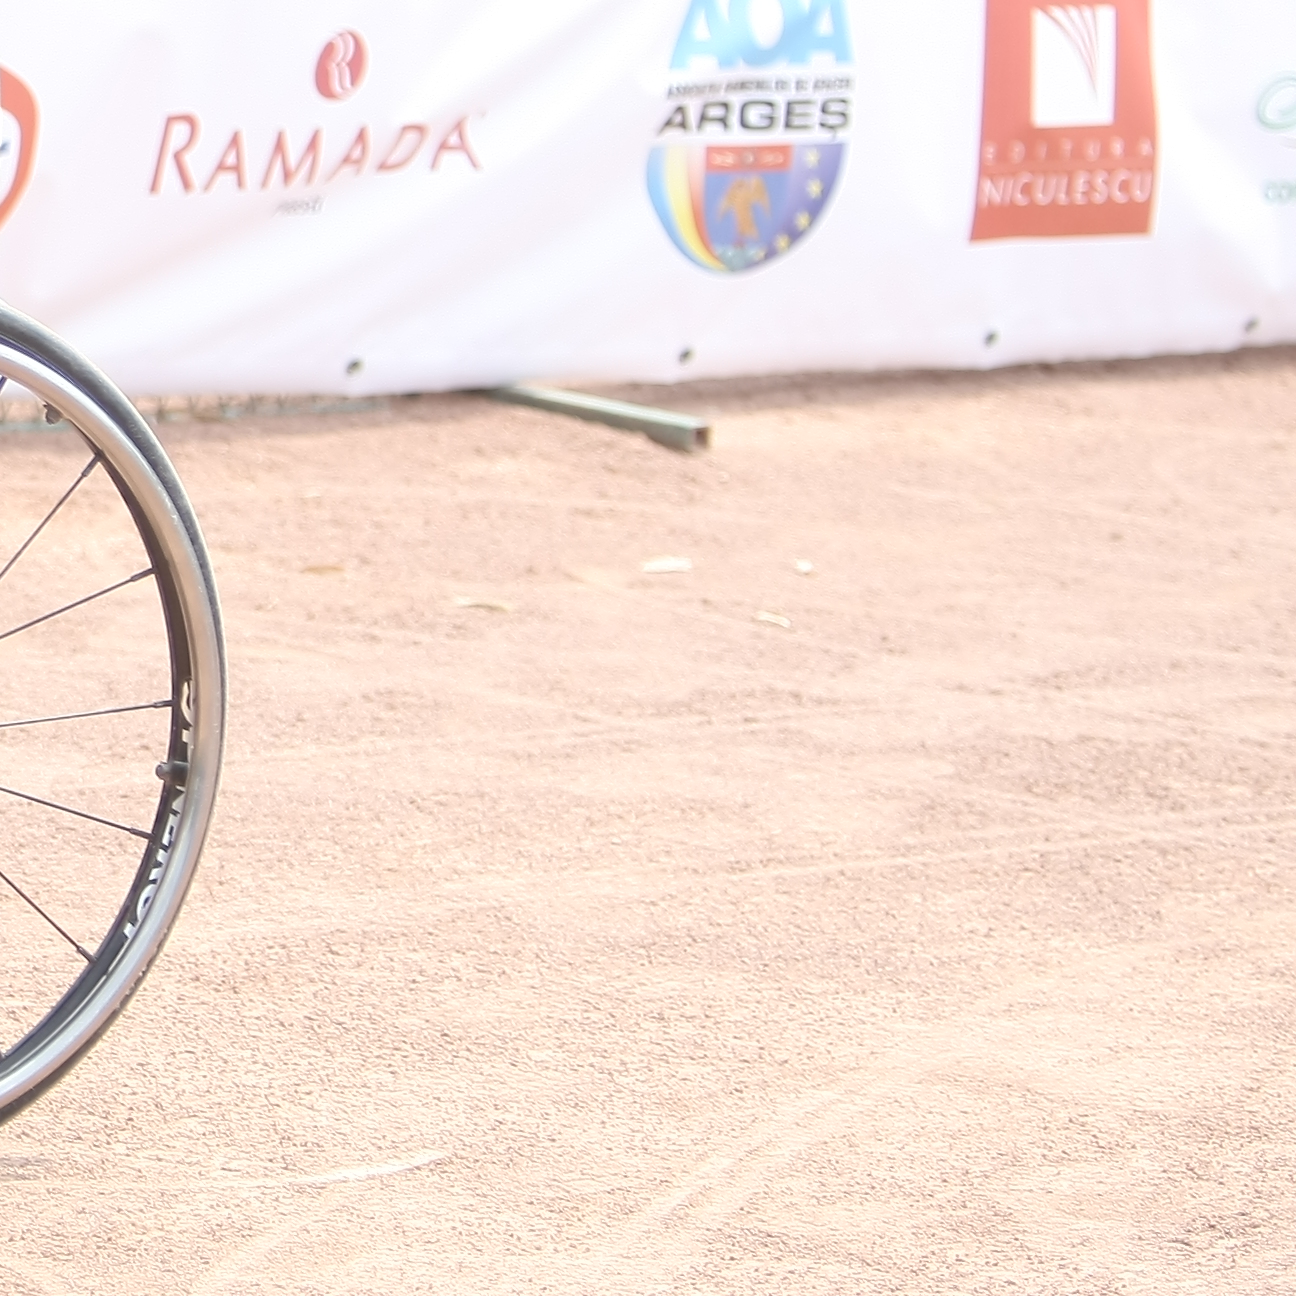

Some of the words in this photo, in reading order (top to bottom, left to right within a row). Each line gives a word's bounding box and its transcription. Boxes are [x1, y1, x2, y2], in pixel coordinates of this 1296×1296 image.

[149, 110, 483, 196] RAMADA
[982, 136, 1154, 165] EDITURA
[977, 168, 1153, 208] NICULESCU
